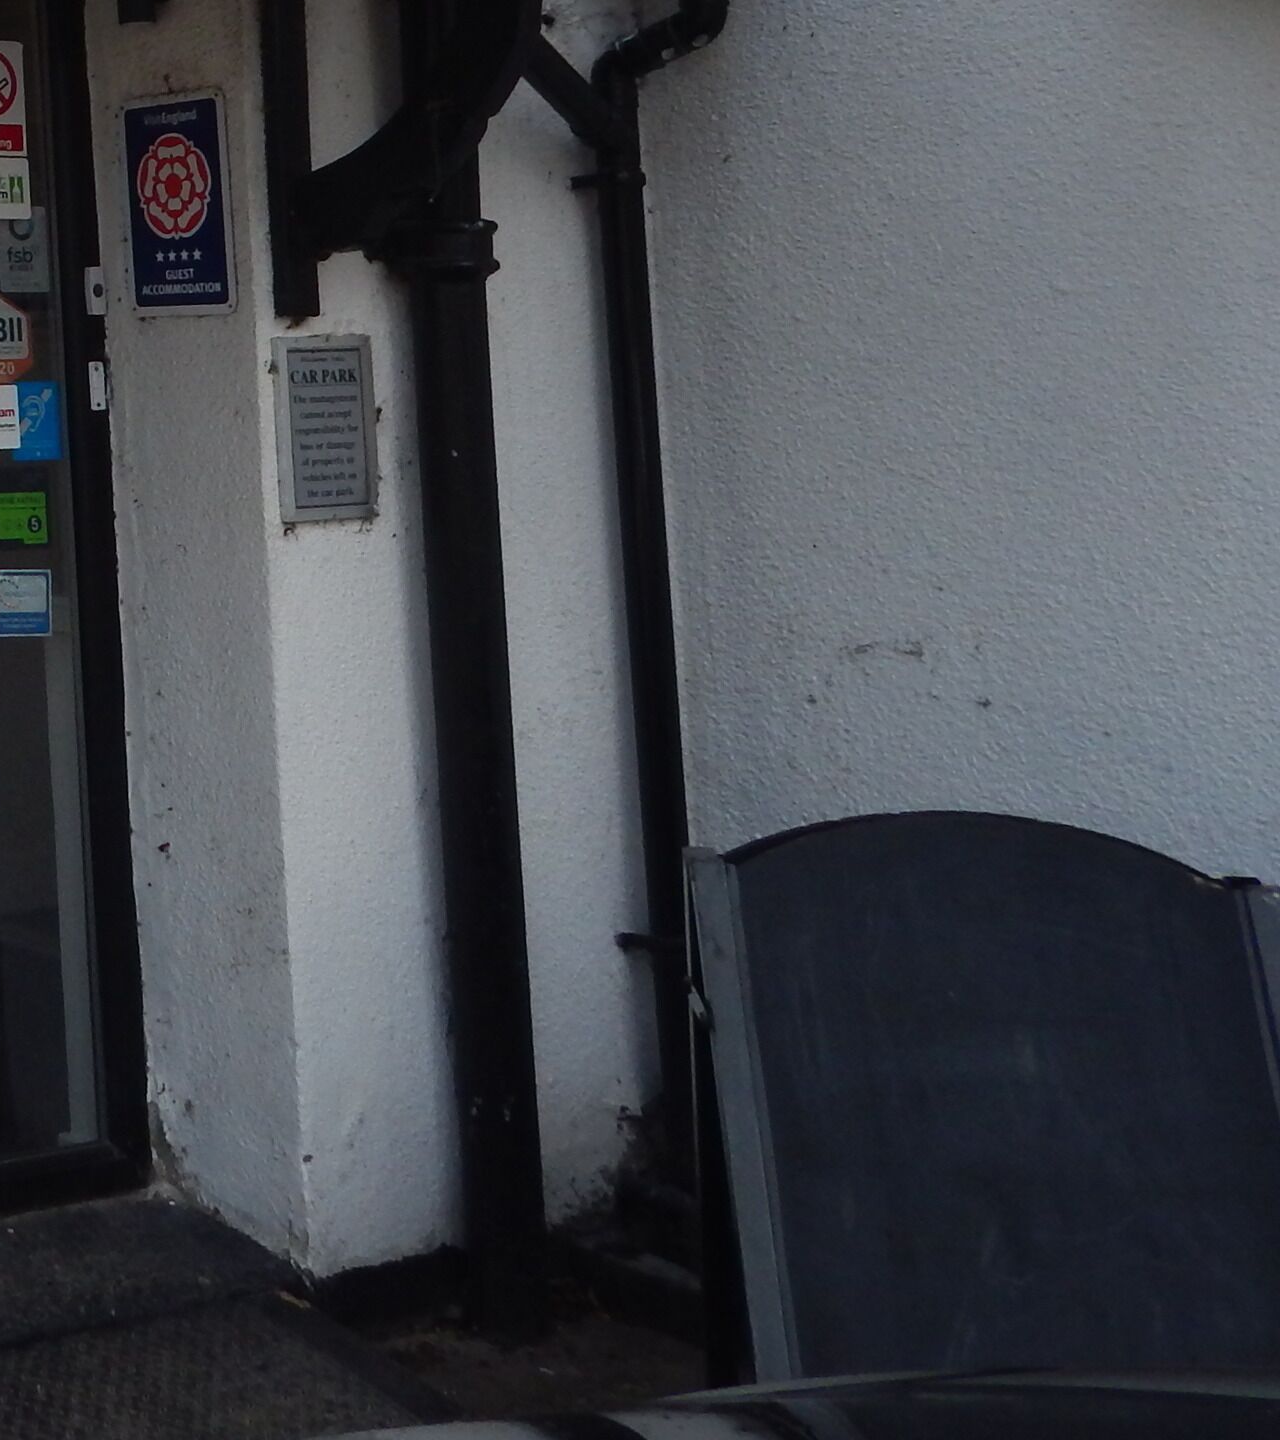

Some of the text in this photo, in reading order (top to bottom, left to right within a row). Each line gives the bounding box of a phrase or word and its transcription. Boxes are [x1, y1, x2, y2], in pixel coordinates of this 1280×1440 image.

[6, 246, 34, 264] fsb
[165, 268, 195, 281] GUEST
[141, 282, 223, 297] ACCOMMODATION
[289, 368, 358, 385] CAR PARK
[31, 516, 40, 532] 5
